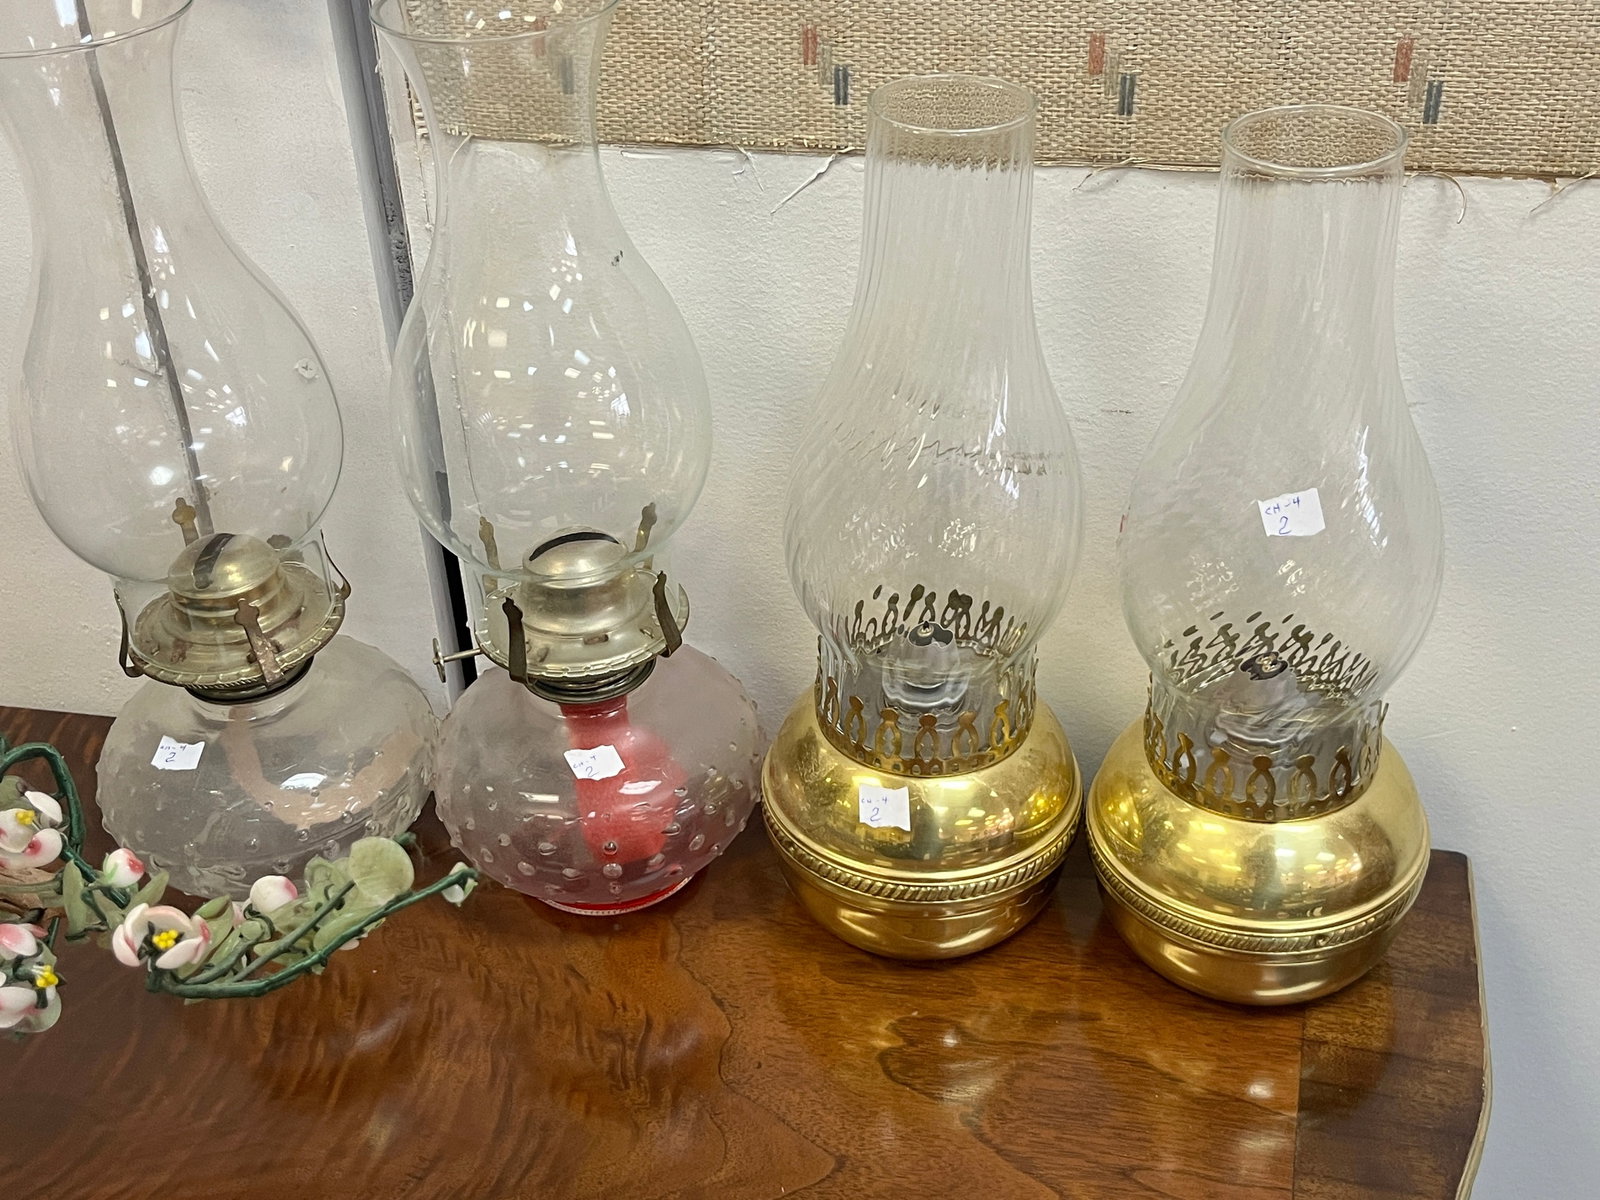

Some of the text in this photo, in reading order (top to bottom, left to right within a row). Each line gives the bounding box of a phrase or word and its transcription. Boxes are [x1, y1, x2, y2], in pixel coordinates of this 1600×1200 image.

[1279, 516, 1292, 535] 2
[165, 752, 176, 762] 2
[585, 766, 600, 778] 2
[870, 807, 882, 822] 2
